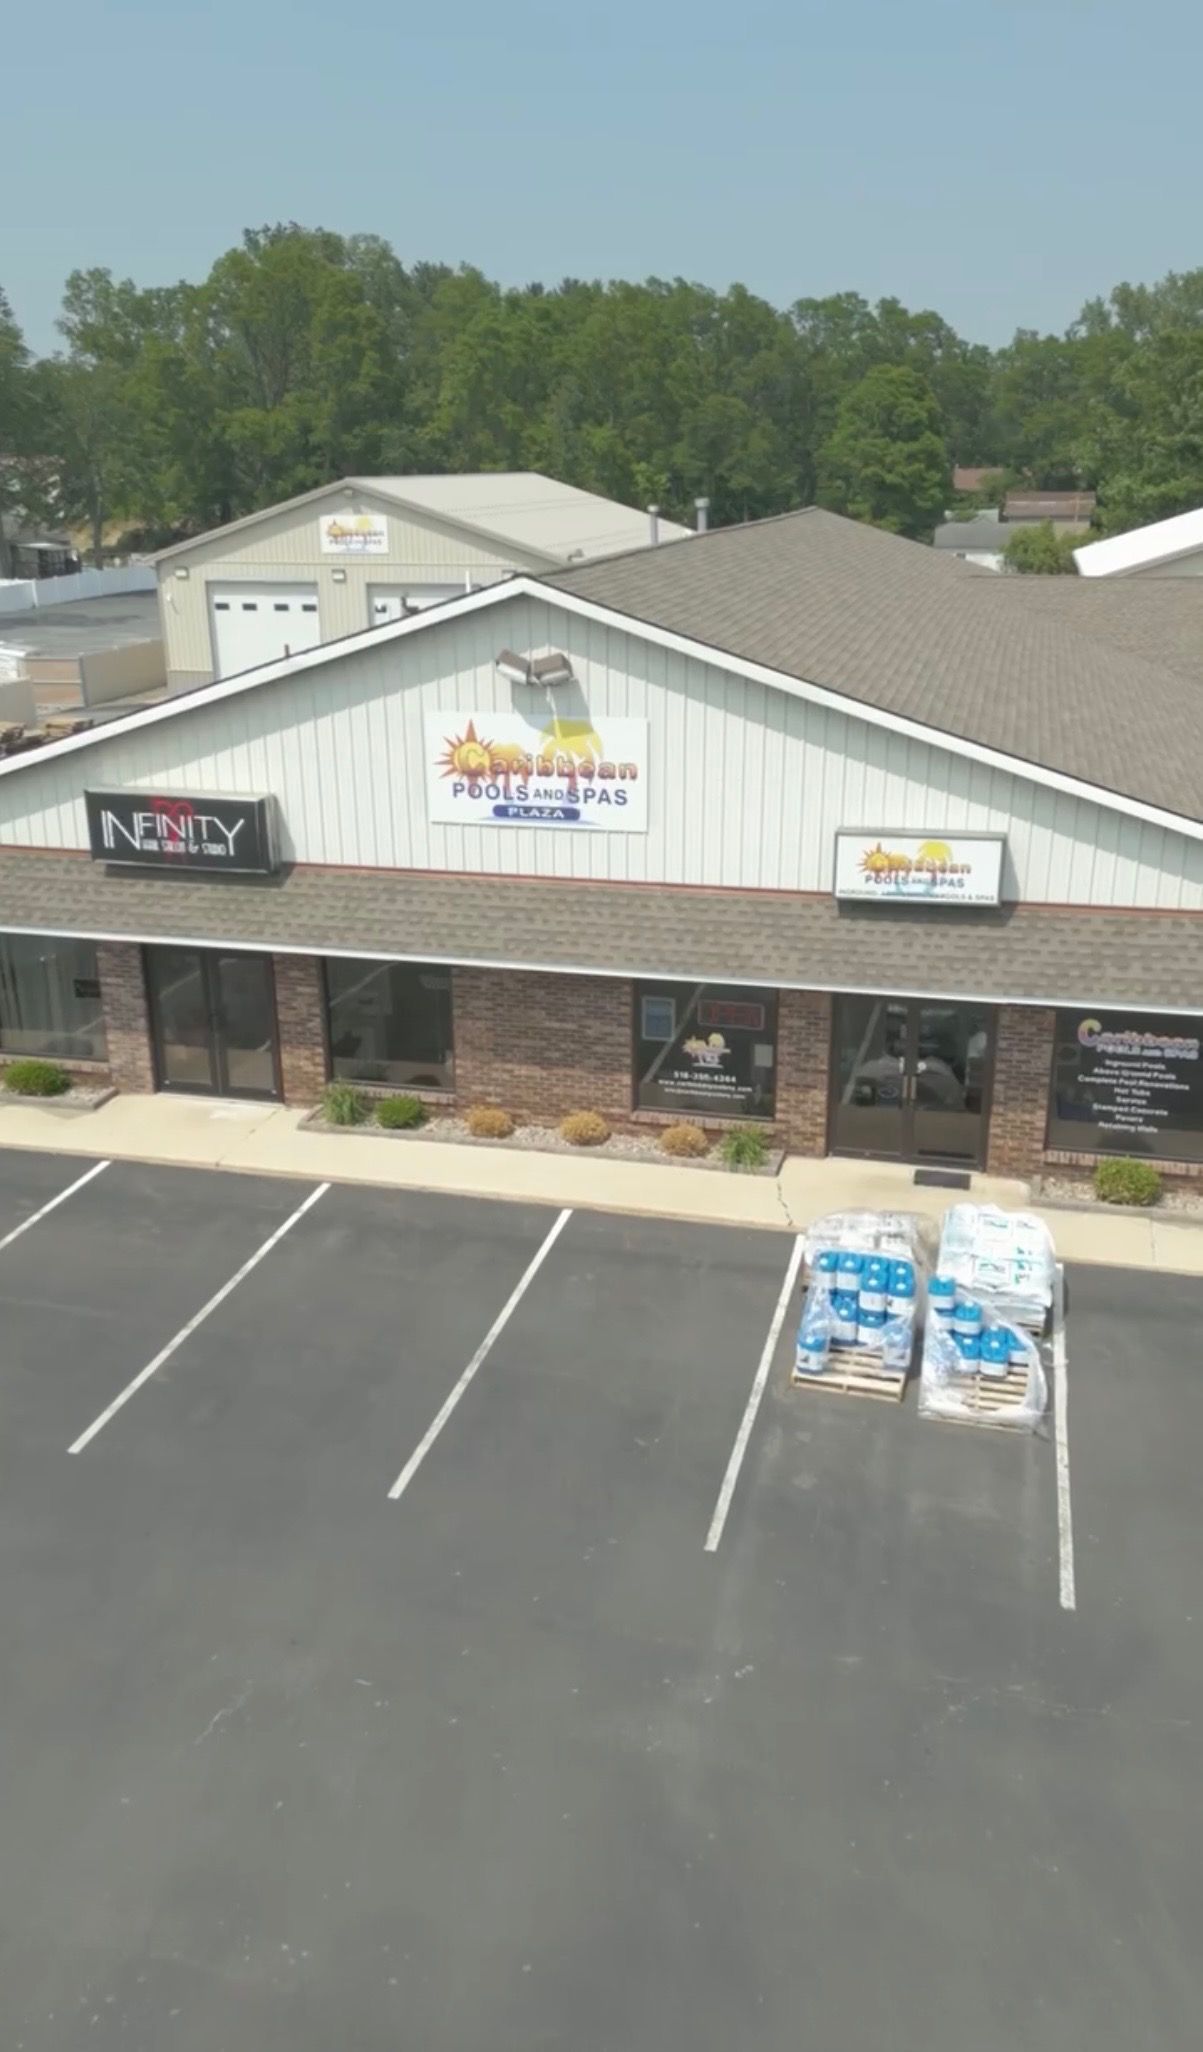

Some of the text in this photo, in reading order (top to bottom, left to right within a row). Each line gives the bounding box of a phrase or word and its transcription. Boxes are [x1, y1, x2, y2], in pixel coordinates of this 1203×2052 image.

[456, 748, 638, 781] Caribbean
[452, 782, 629, 806] POOLS AND SPAS
[507, 806, 566, 819] PLAZA
[101, 809, 245, 857] INFINITY
[865, 874, 909, 886] POOLS
[931, 877, 965, 888] SPAS
